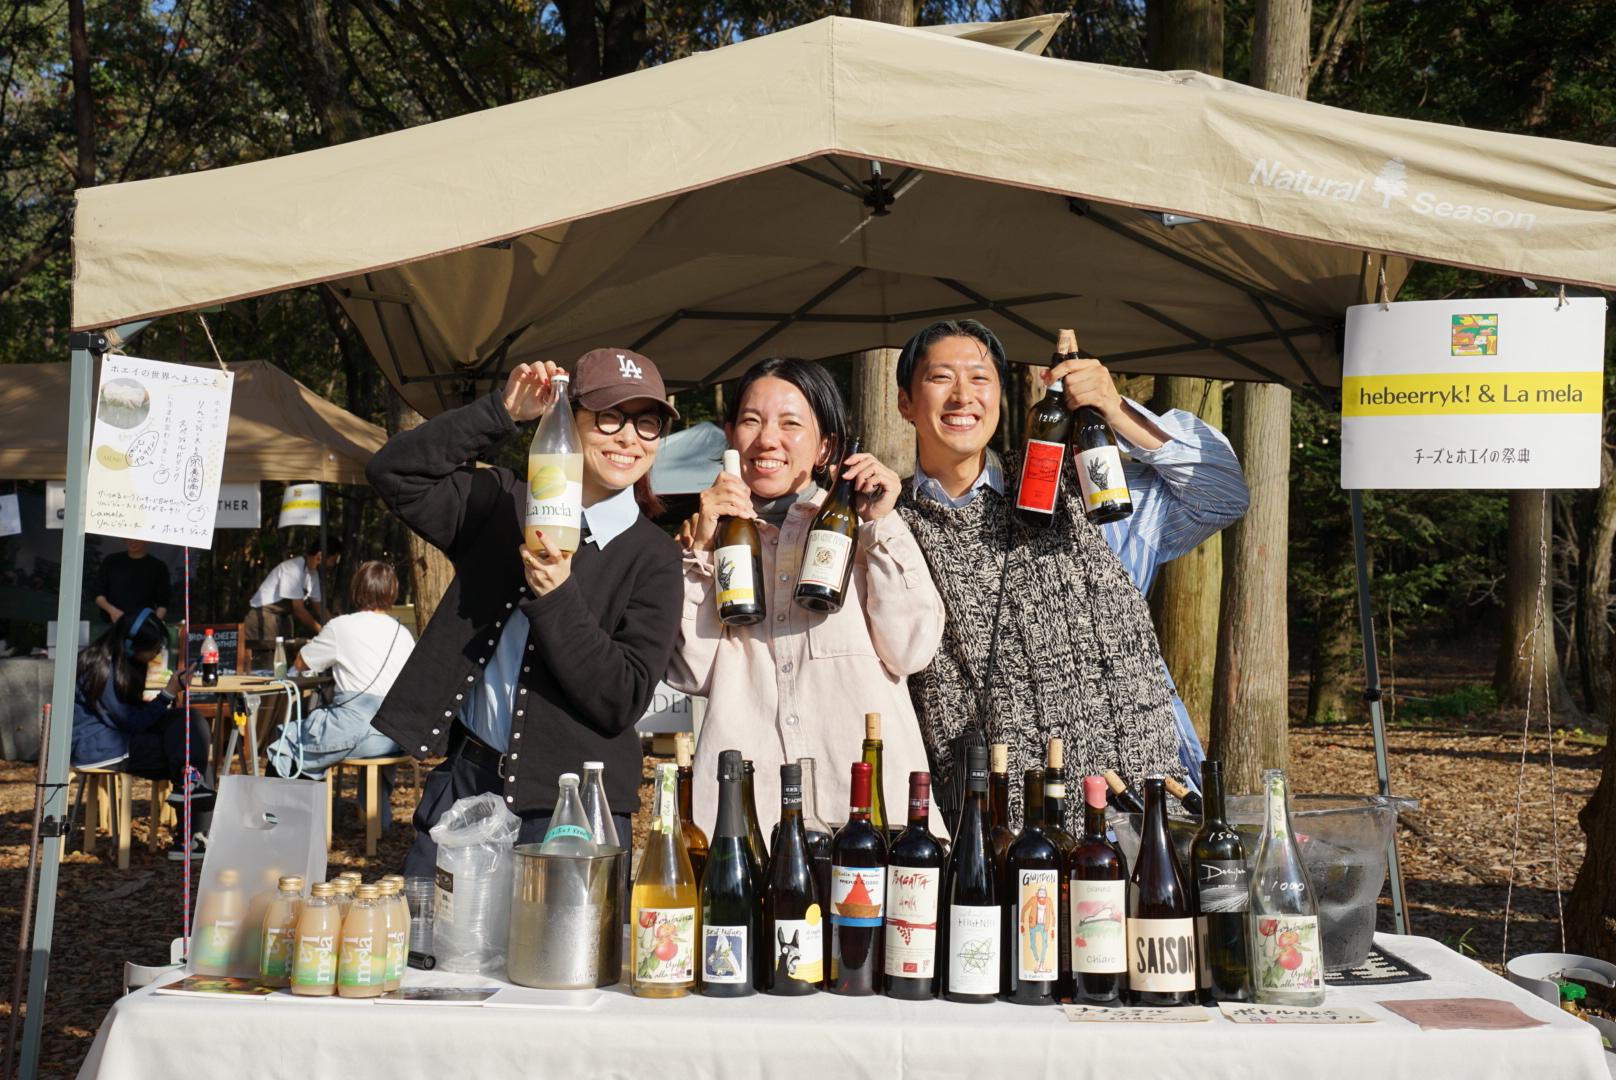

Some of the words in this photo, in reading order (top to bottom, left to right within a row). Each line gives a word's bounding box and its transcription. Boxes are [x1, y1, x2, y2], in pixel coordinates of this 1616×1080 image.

[1248, 158, 1365, 202] Natural
[1411, 191, 1536, 231] Season
[111, 365, 219, 388] ホエイの世界へようこそ
[616, 354, 643, 379] LA
[1360, 385, 1470, 406] hebeerryk!
[1478, 384, 1495, 403] &
[1503, 384, 1529, 403] La
[1536, 384, 1583, 402] mela
[1413, 448, 1530, 464] チーズとホエイの祭典
[217, 500, 249, 511] THER
[541, 502, 572, 517] mela
[1208, 831, 1239, 843] 1500
[1271, 880, 1305, 892] 1000
[317, 935, 334, 983] mela
[357, 936, 373, 984] mela
[1136, 935, 1194, 976] SAISON
